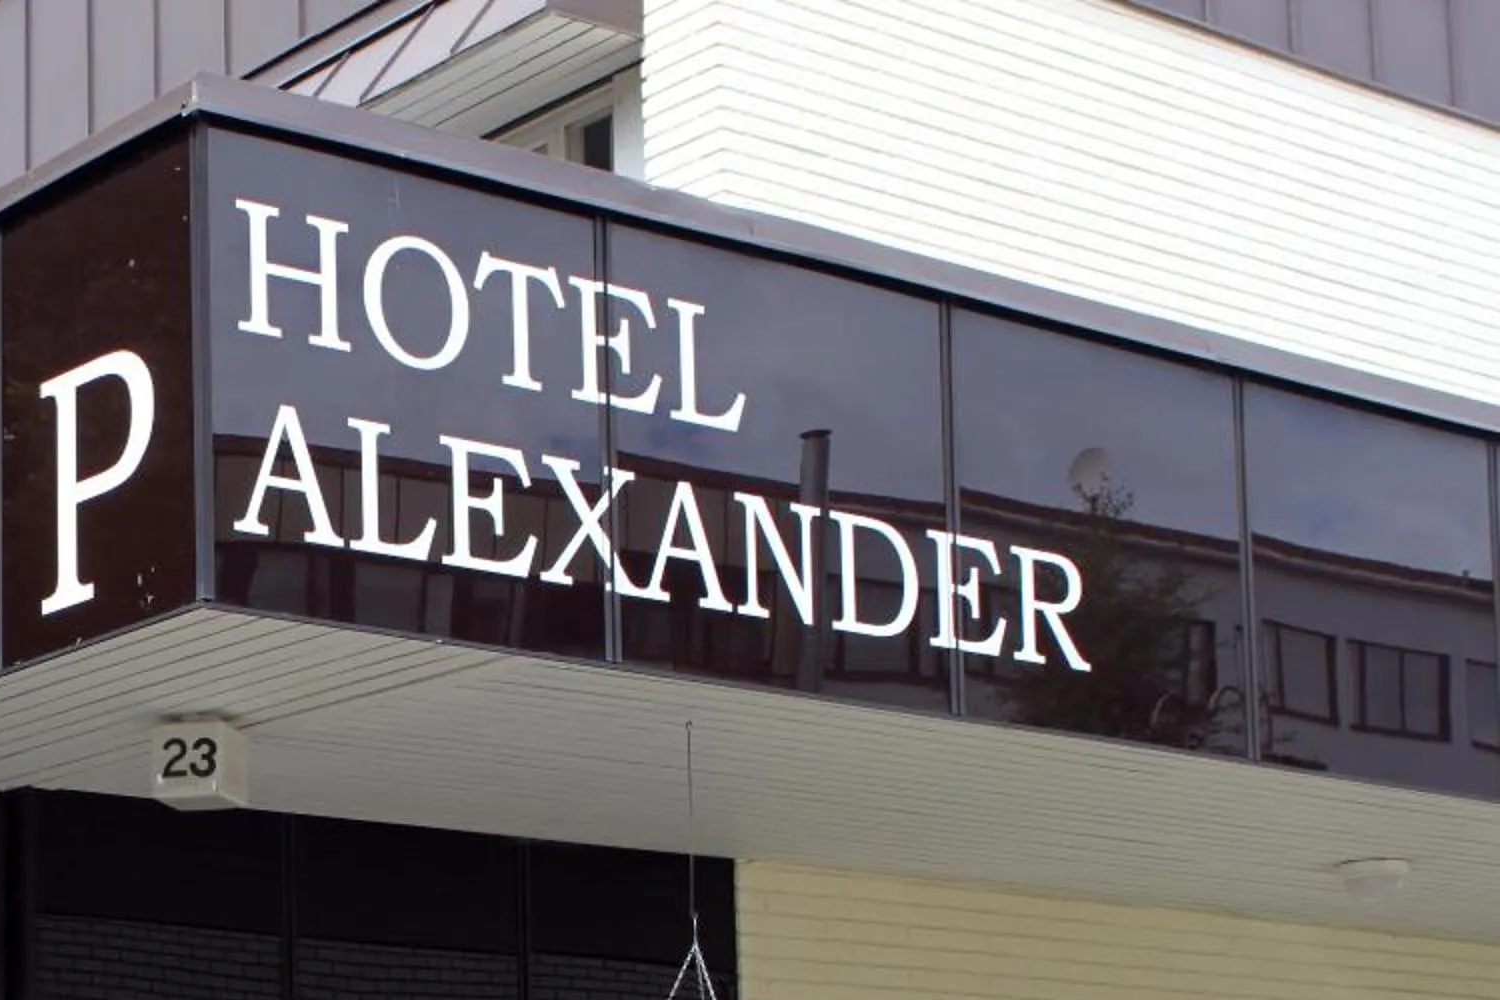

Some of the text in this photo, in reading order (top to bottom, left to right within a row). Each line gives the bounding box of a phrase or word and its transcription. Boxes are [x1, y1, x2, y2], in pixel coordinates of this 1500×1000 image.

[235, 198, 748, 433] HOTEL
[233, 404, 1092, 673] ALEXANDER
[162, 737, 217, 778] 23
